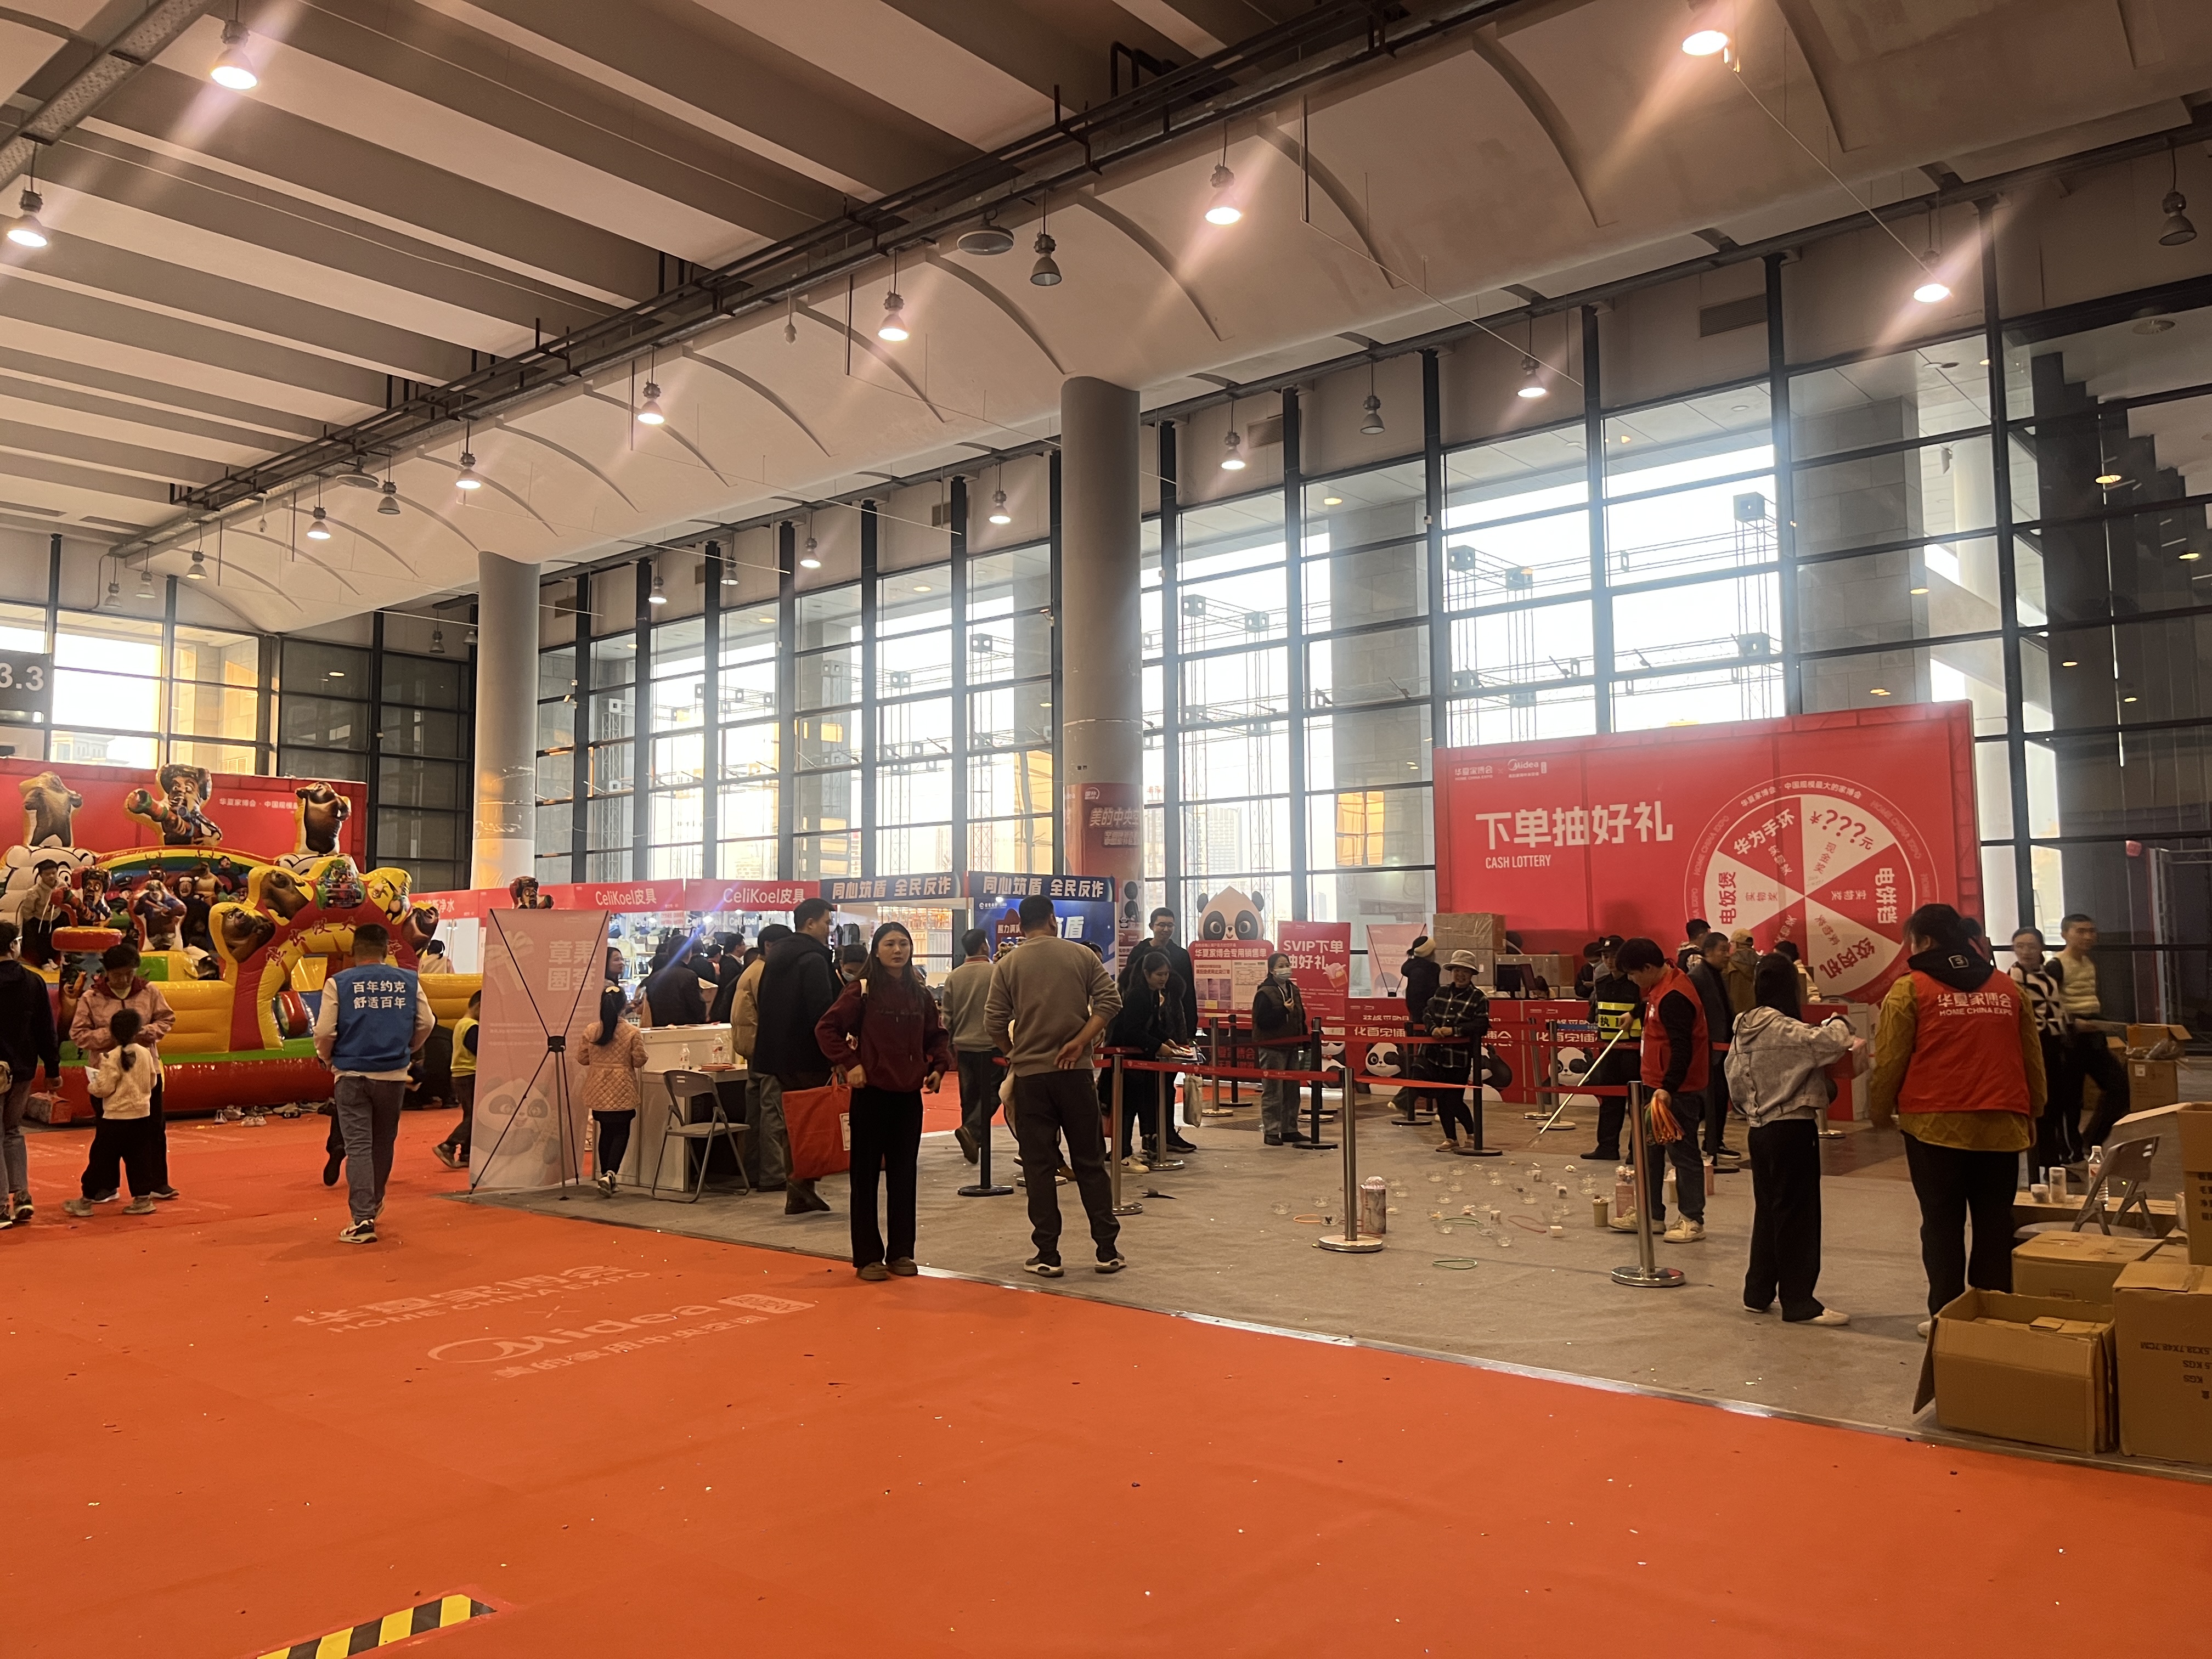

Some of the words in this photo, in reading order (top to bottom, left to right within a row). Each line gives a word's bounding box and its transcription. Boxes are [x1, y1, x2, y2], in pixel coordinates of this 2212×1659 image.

[1508, 759, 1539, 771] Midea
[1475, 800, 1673, 850] 下单抽好礼
[1734, 809, 1795, 854] 华为手环
[1486, 856, 1510, 869] CASH
[1512, 854, 1551, 868] LOTTERY
[1814, 842, 1837, 874] 现金奖
[832, 880, 887, 900] 同心筑盾
[894, 876, 952, 897] 全民反诈
[983, 876, 1042, 895] 同心筑盾
[1049, 878, 1104, 898] 全民反诈
[1831, 889, 1866, 901] 实物奖
[595, 888, 657, 906] CeliKoel皮具
[723, 888, 805, 904] CeliKoel皮具
[1719, 872, 1736, 924] 电饭煲
[1745, 892, 1778, 901] 实物奖
[1875, 868, 1897, 924] 电饼铛
[1195, 949, 1267, 957] 华夏家博会专用销售单
[1283, 940, 1344, 953] SVIP下单
[1819, 937, 1875, 979] 绞肉机
[352, 980, 406, 994] 百年约克
[354, 996, 406, 1009] 舒适百年
[1937, 992, 2012, 1008] 华夏家博会
[1939, 1008, 1965, 1017] HOME
[1994, 1007, 2013, 1015] EXPO
[294, 1266, 631, 1325] 华夏家博会
[328, 1309, 447, 1333] HOME
[451, 1288, 562, 1310] CHINA
[565, 1272, 650, 1290] EXPO
[428, 1305, 721, 1363] Midea
[495, 1316, 770, 1379] 美的家用中央空调
[2183, 1361, 2202, 1369] KGS
[2183, 1374, 2203, 1384] KGS
